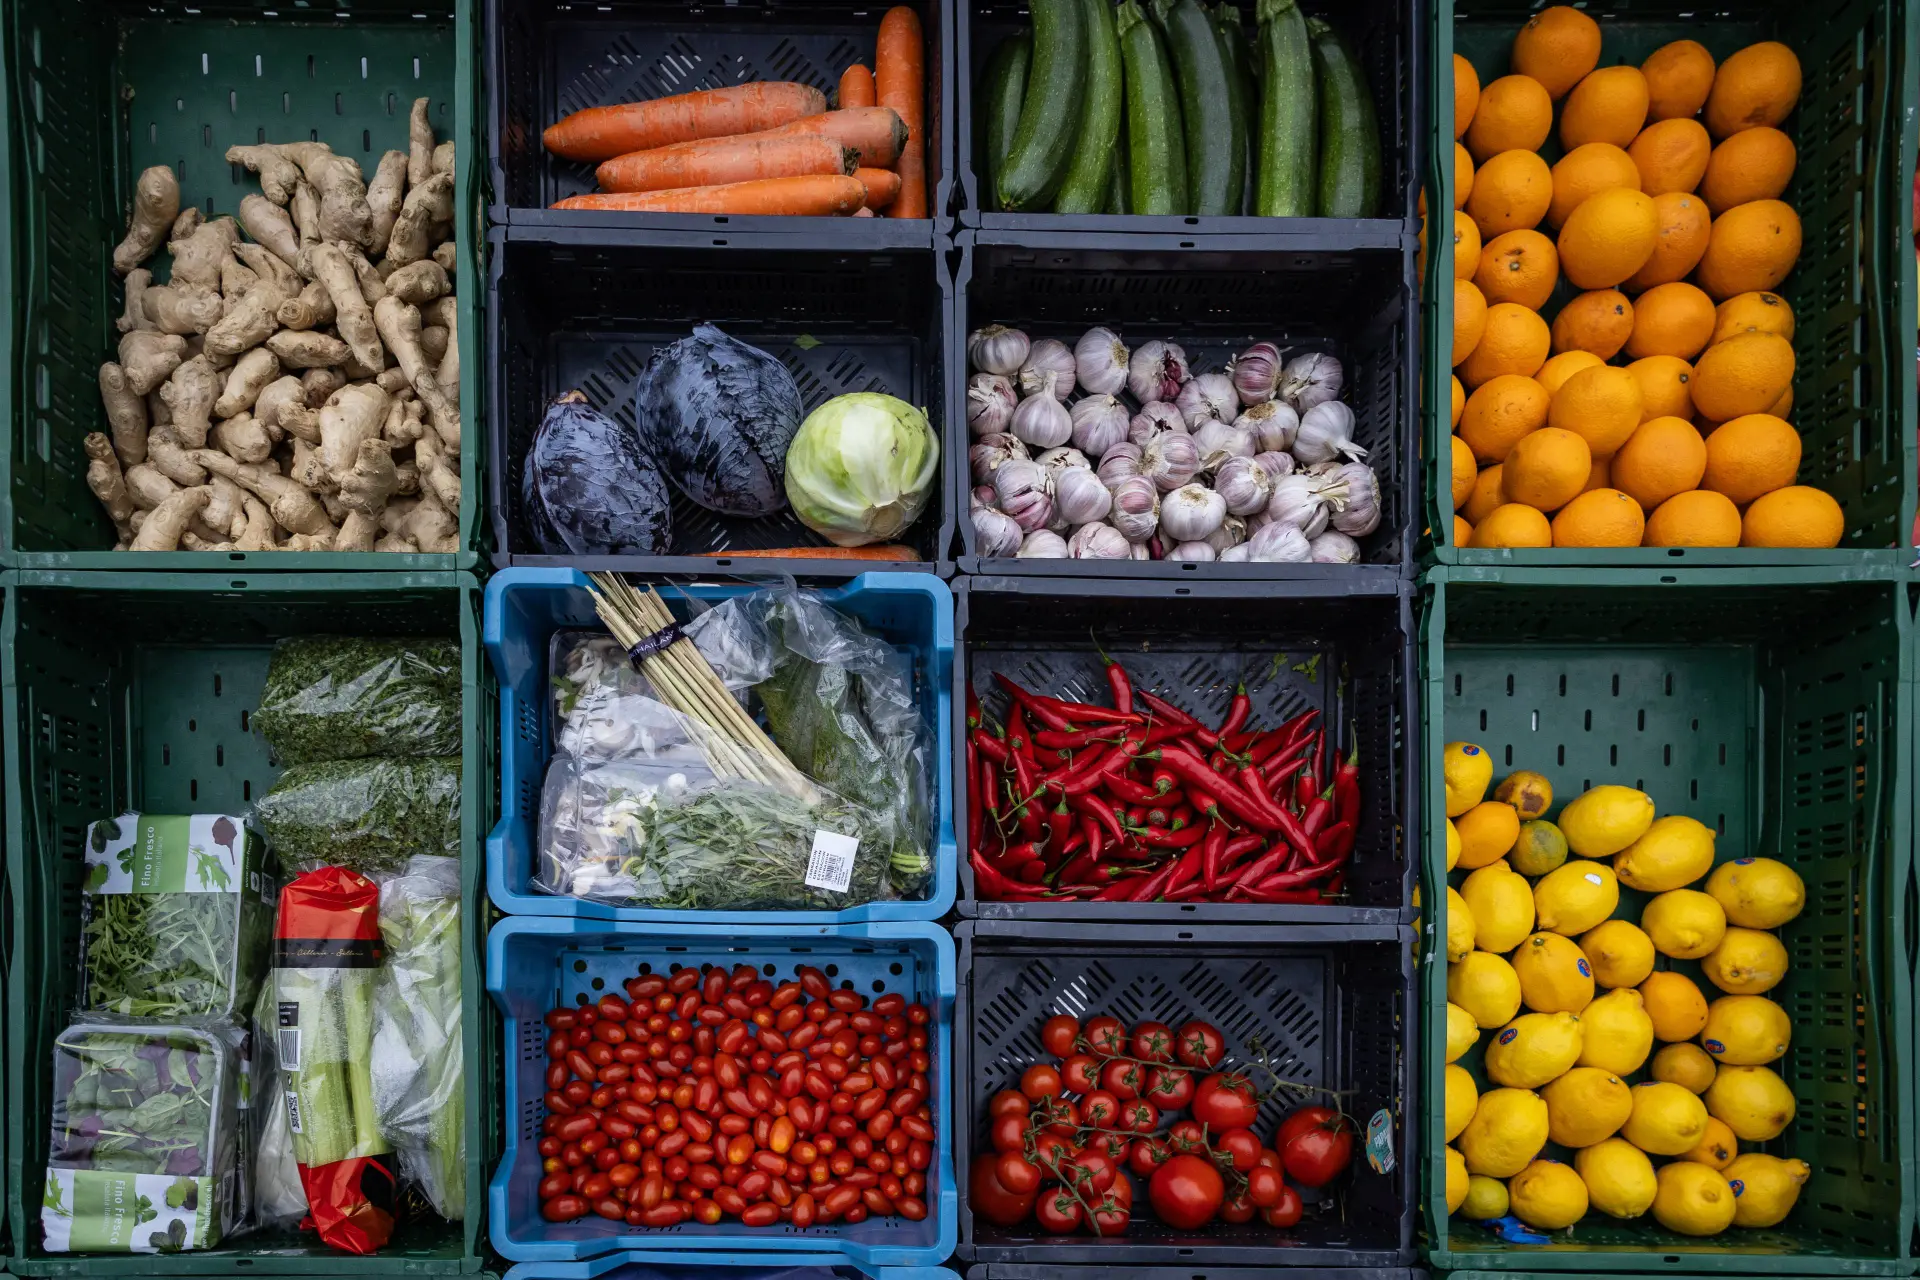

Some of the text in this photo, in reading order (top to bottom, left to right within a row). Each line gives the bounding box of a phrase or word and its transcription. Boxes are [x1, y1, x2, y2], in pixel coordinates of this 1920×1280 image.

[634, 630, 674, 655] THAILAN
[141, 826, 155, 887] Fino Fresco
[110, 1180, 126, 1245] Fino Fresco
